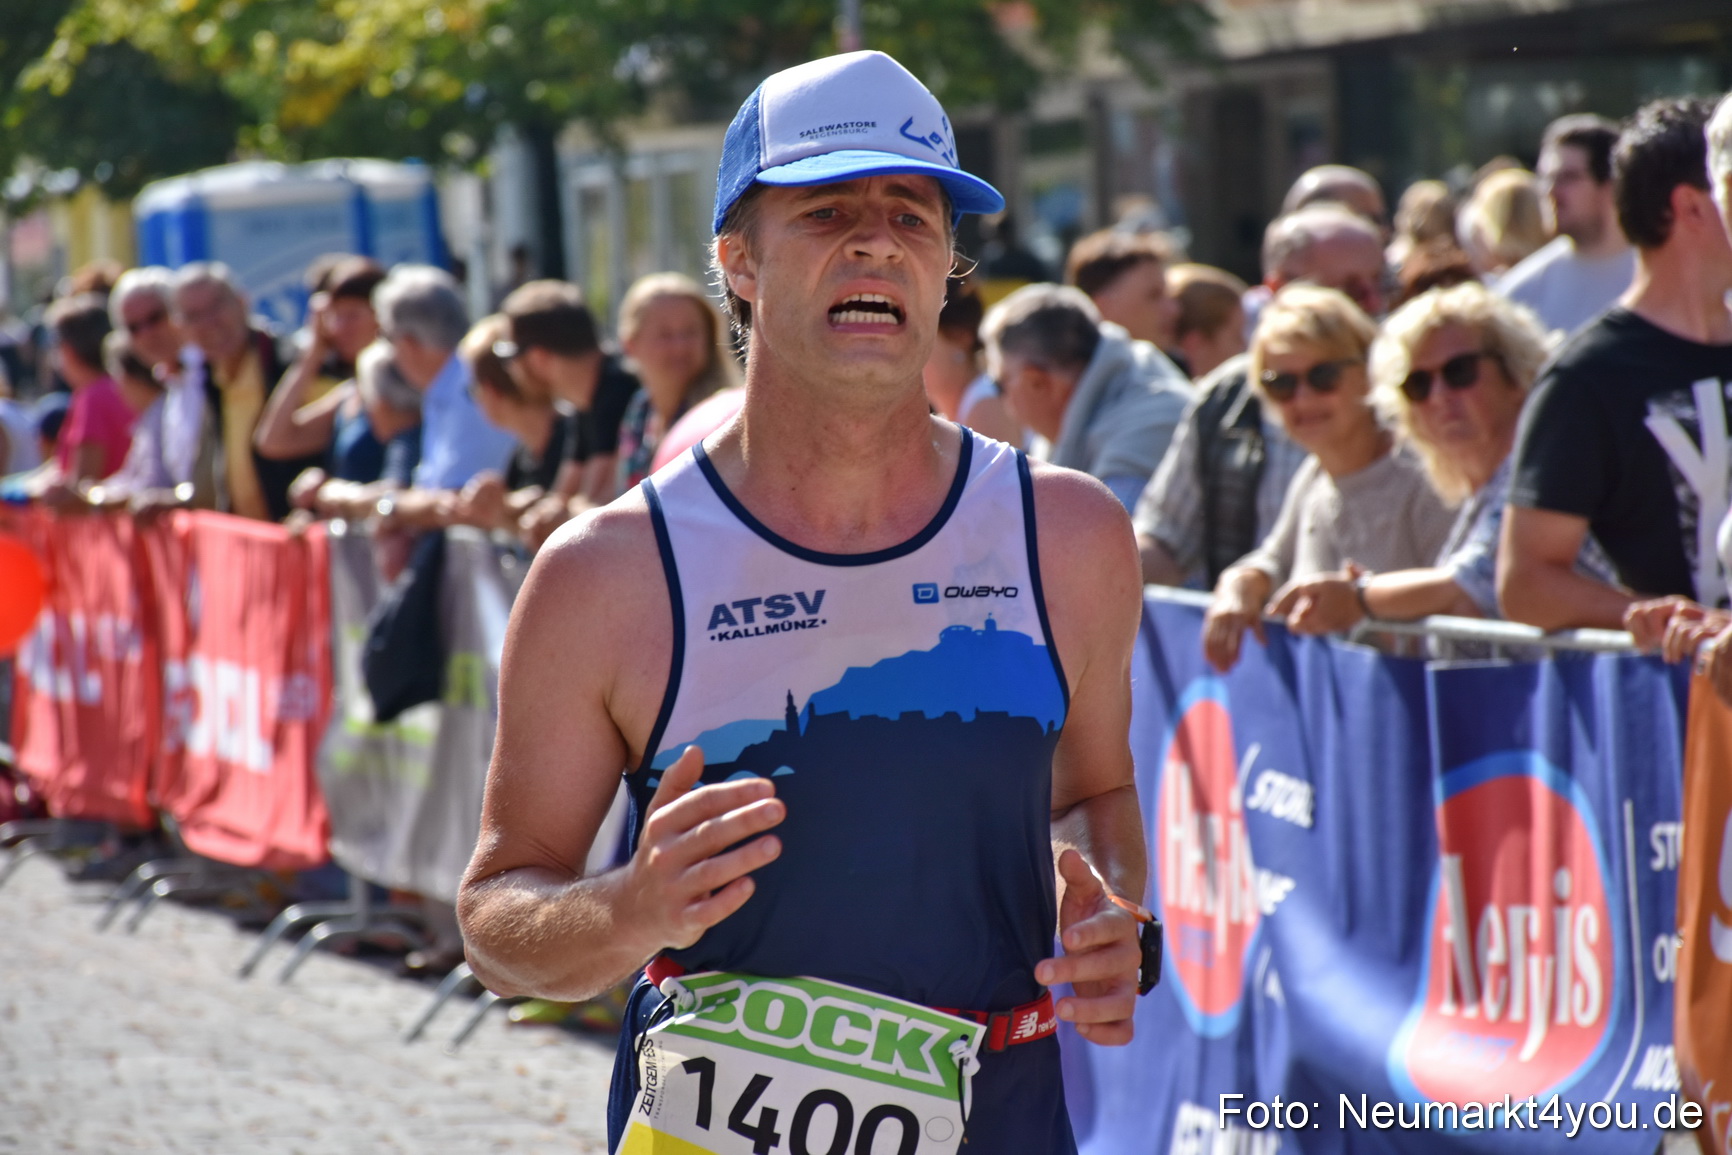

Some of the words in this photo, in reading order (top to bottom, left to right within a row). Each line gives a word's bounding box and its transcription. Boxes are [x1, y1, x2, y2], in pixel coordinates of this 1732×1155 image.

[799, 121, 877, 139] SALEWASTORE
[809, 127, 868, 140] REGENSBURG
[707, 589, 827, 631] ATSV
[680, 979, 951, 1088] BOCK
[682, 1056, 920, 1155] 1400
